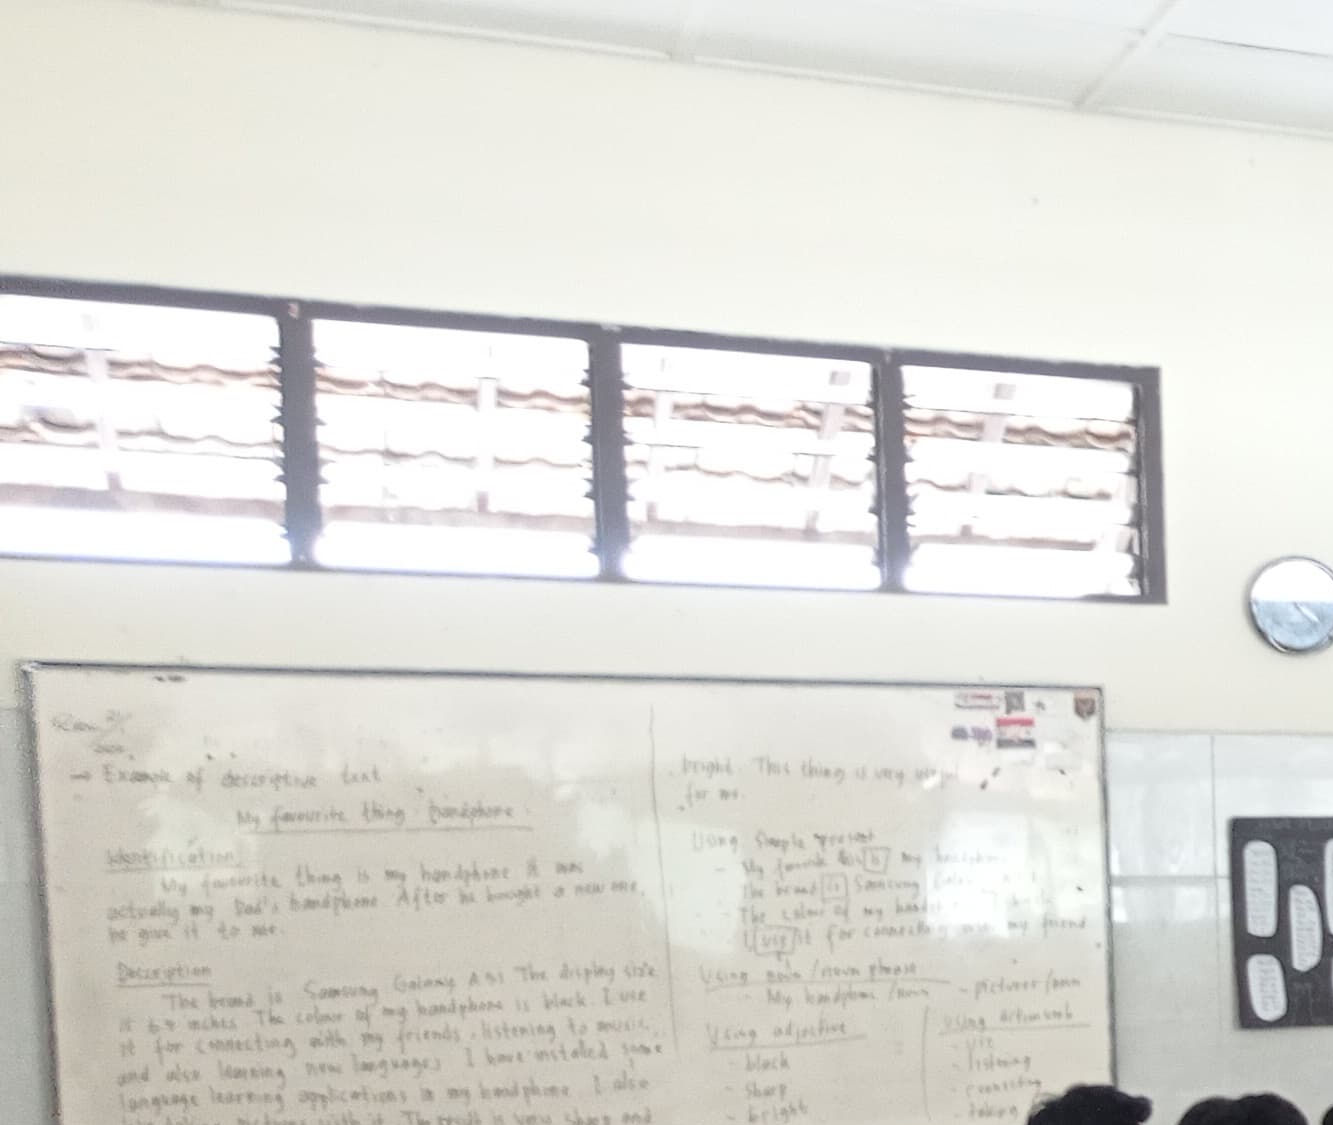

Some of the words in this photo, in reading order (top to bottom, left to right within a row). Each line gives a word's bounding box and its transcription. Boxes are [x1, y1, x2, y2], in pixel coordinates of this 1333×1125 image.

[103, 763, 172, 788] Example
[187, 766, 203, 792] of
[221, 769, 317, 790] descriptive
[341, 763, 382, 784] text
[752, 755, 791, 775] This
[802, 756, 845, 785] thing
[855, 767, 866, 780] is
[875, 765, 905, 788] very
[686, 780, 708, 807] for
[362, 801, 405, 825] thing
[902, 850, 922, 871] my
[296, 864, 342, 892] thing
[358, 866, 370, 881] is
[384, 867, 406, 883] my
[420, 861, 511, 886] handphone
[190, 904, 214, 921] my
[291, 891, 378, 916] handphone
[398, 885, 446, 912] After
[460, 886, 475, 905] he
[553, 886, 565, 898] a
[575, 882, 604, 896] new
[184, 921, 198, 939] it
[217, 920, 240, 940] to
[826, 924, 855, 952] for
[162, 994, 198, 1011] The
[208, 990, 254, 1009] brand
[269, 986, 283, 1006] is
[304, 979, 379, 1006] Samsung
[513, 963, 547, 983] The
[560, 962, 616, 985] display
[252, 1008, 284, 1026] The
[356, 1004, 370, 1027] of
[382, 1004, 408, 1025] my
[416, 995, 503, 1020] handphone
[515, 998, 530, 1013] is
[619, 989, 647, 1003] use
[153, 1034, 184, 1065] for
[195, 1033, 296, 1059] connecting
[308, 1029, 346, 1048] with
[361, 1031, 384, 1052] my
[481, 1020, 556, 1043] listening
[568, 1017, 588, 1035] to
[117, 1064, 149, 1087] and
[166, 1064, 200, 1082] also
[218, 1059, 286, 1090] learning
[305, 1060, 342, 1076] new
[485, 1047, 523, 1066] have
[621, 1042, 663, 1057] some
[745, 1050, 790, 1073] black
[119, 1093, 199, 1118] language
[208, 1085, 285, 1113] learning
[298, 1083, 406, 1111] applications
[447, 1086, 471, 1107] my
[480, 1078, 569, 1105] handphone
[613, 1069, 649, 1091] also
[748, 1098, 809, 1124] bright
